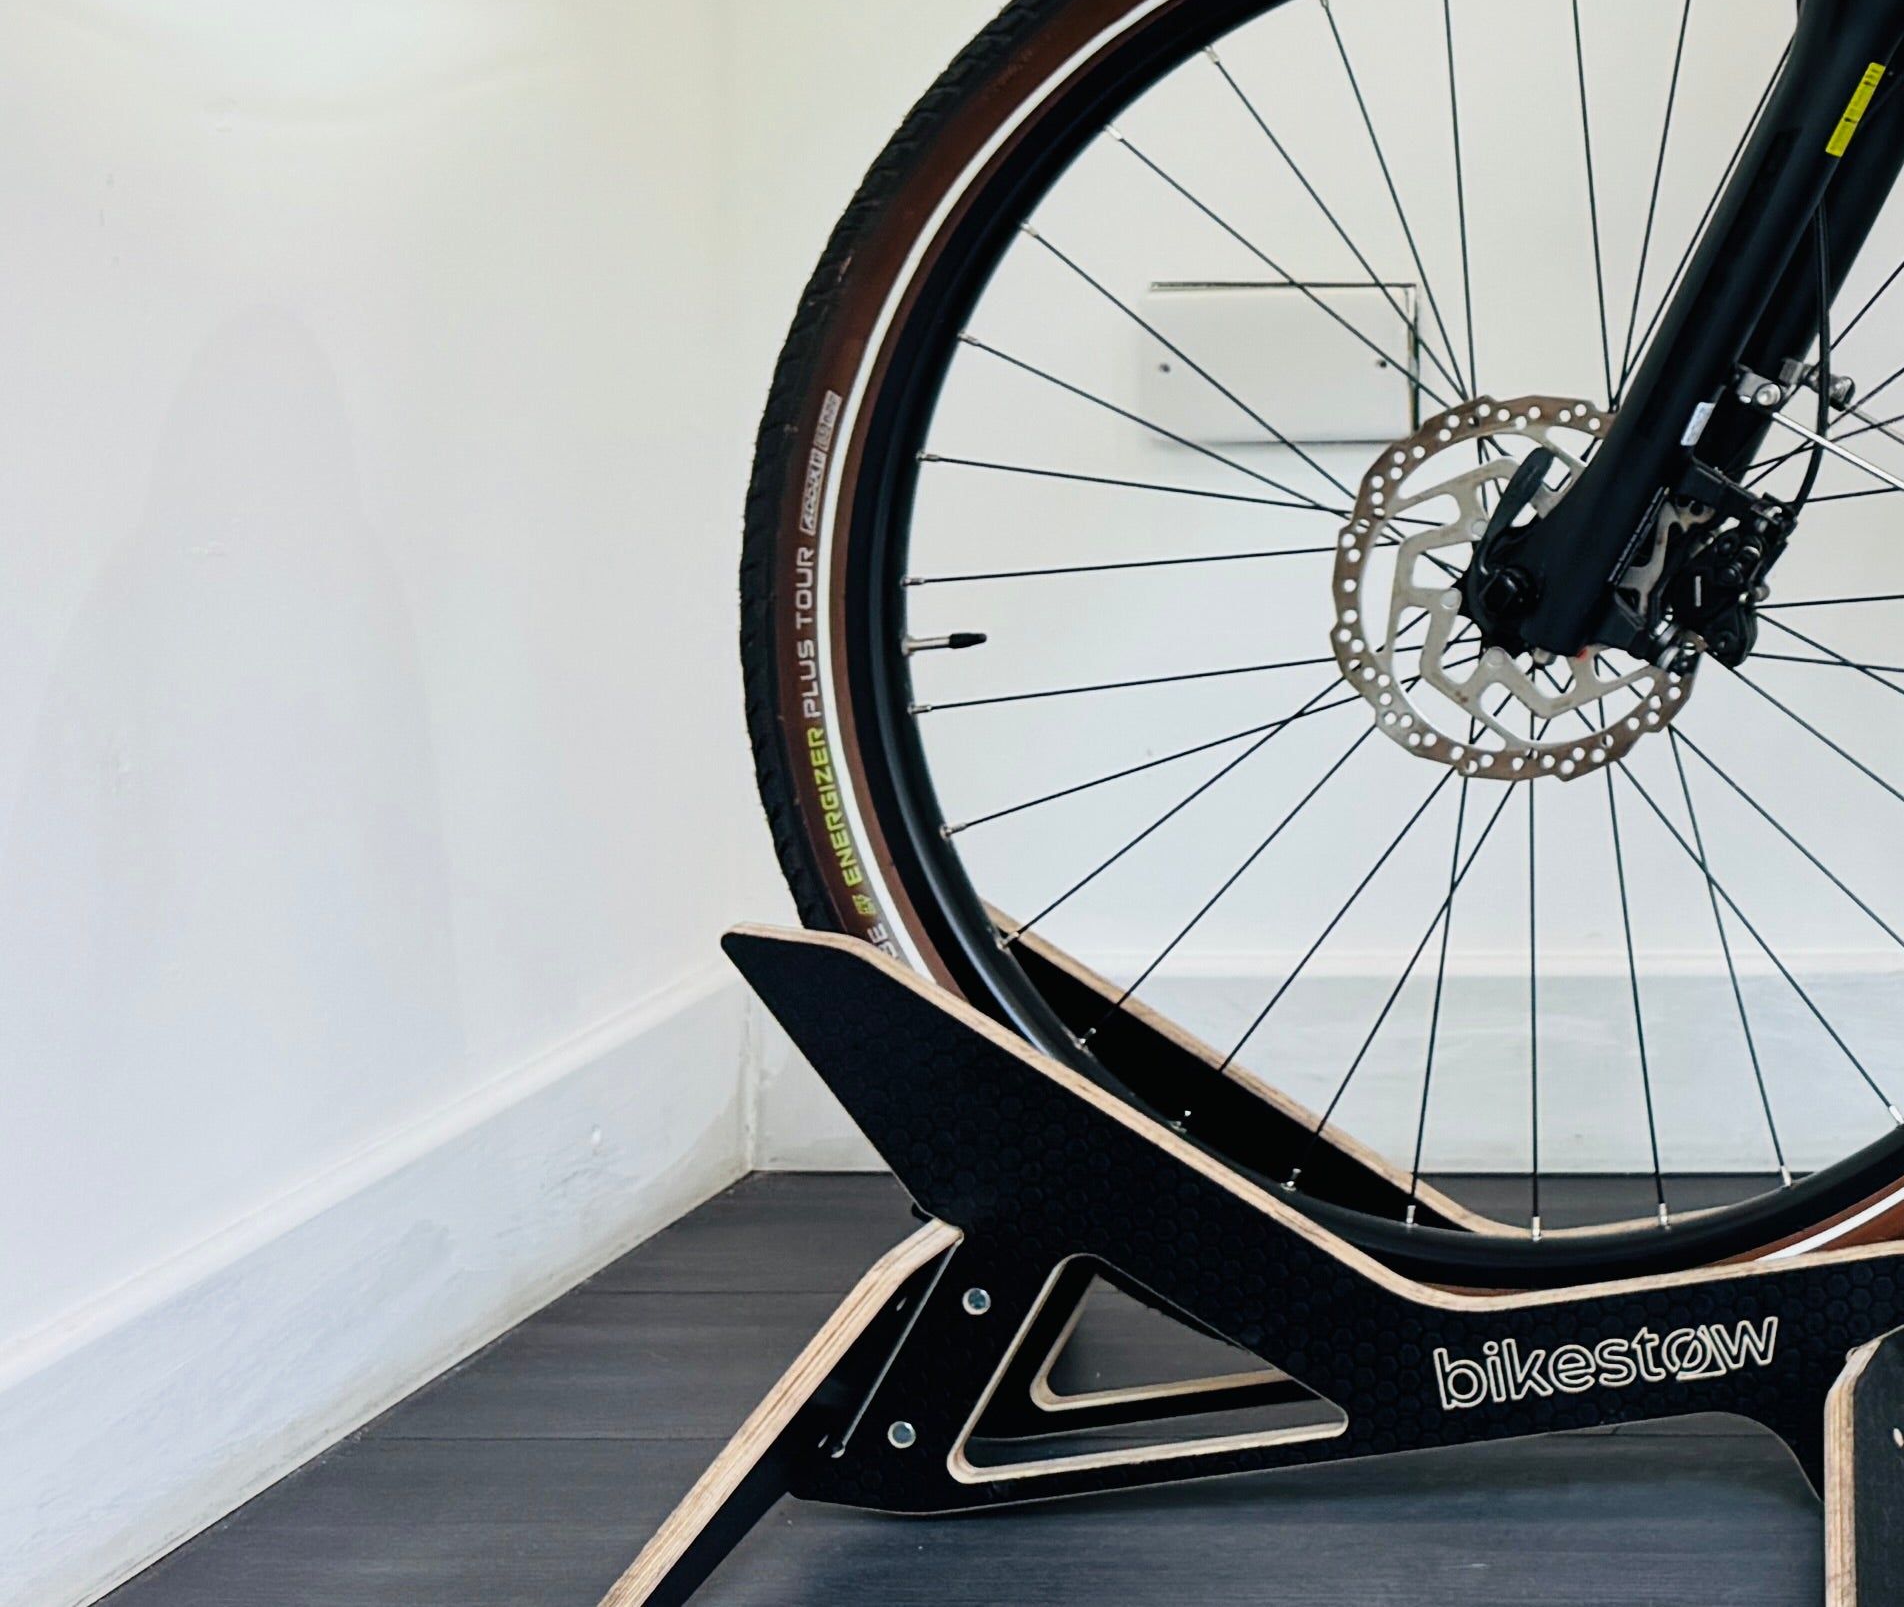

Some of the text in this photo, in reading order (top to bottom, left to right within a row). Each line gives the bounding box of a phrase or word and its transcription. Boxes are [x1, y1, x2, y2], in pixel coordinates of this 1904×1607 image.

[796, 545, 815, 630] TOUR
[797, 639, 820, 719] PLUS
[807, 727, 864, 888] ENERGIZER
